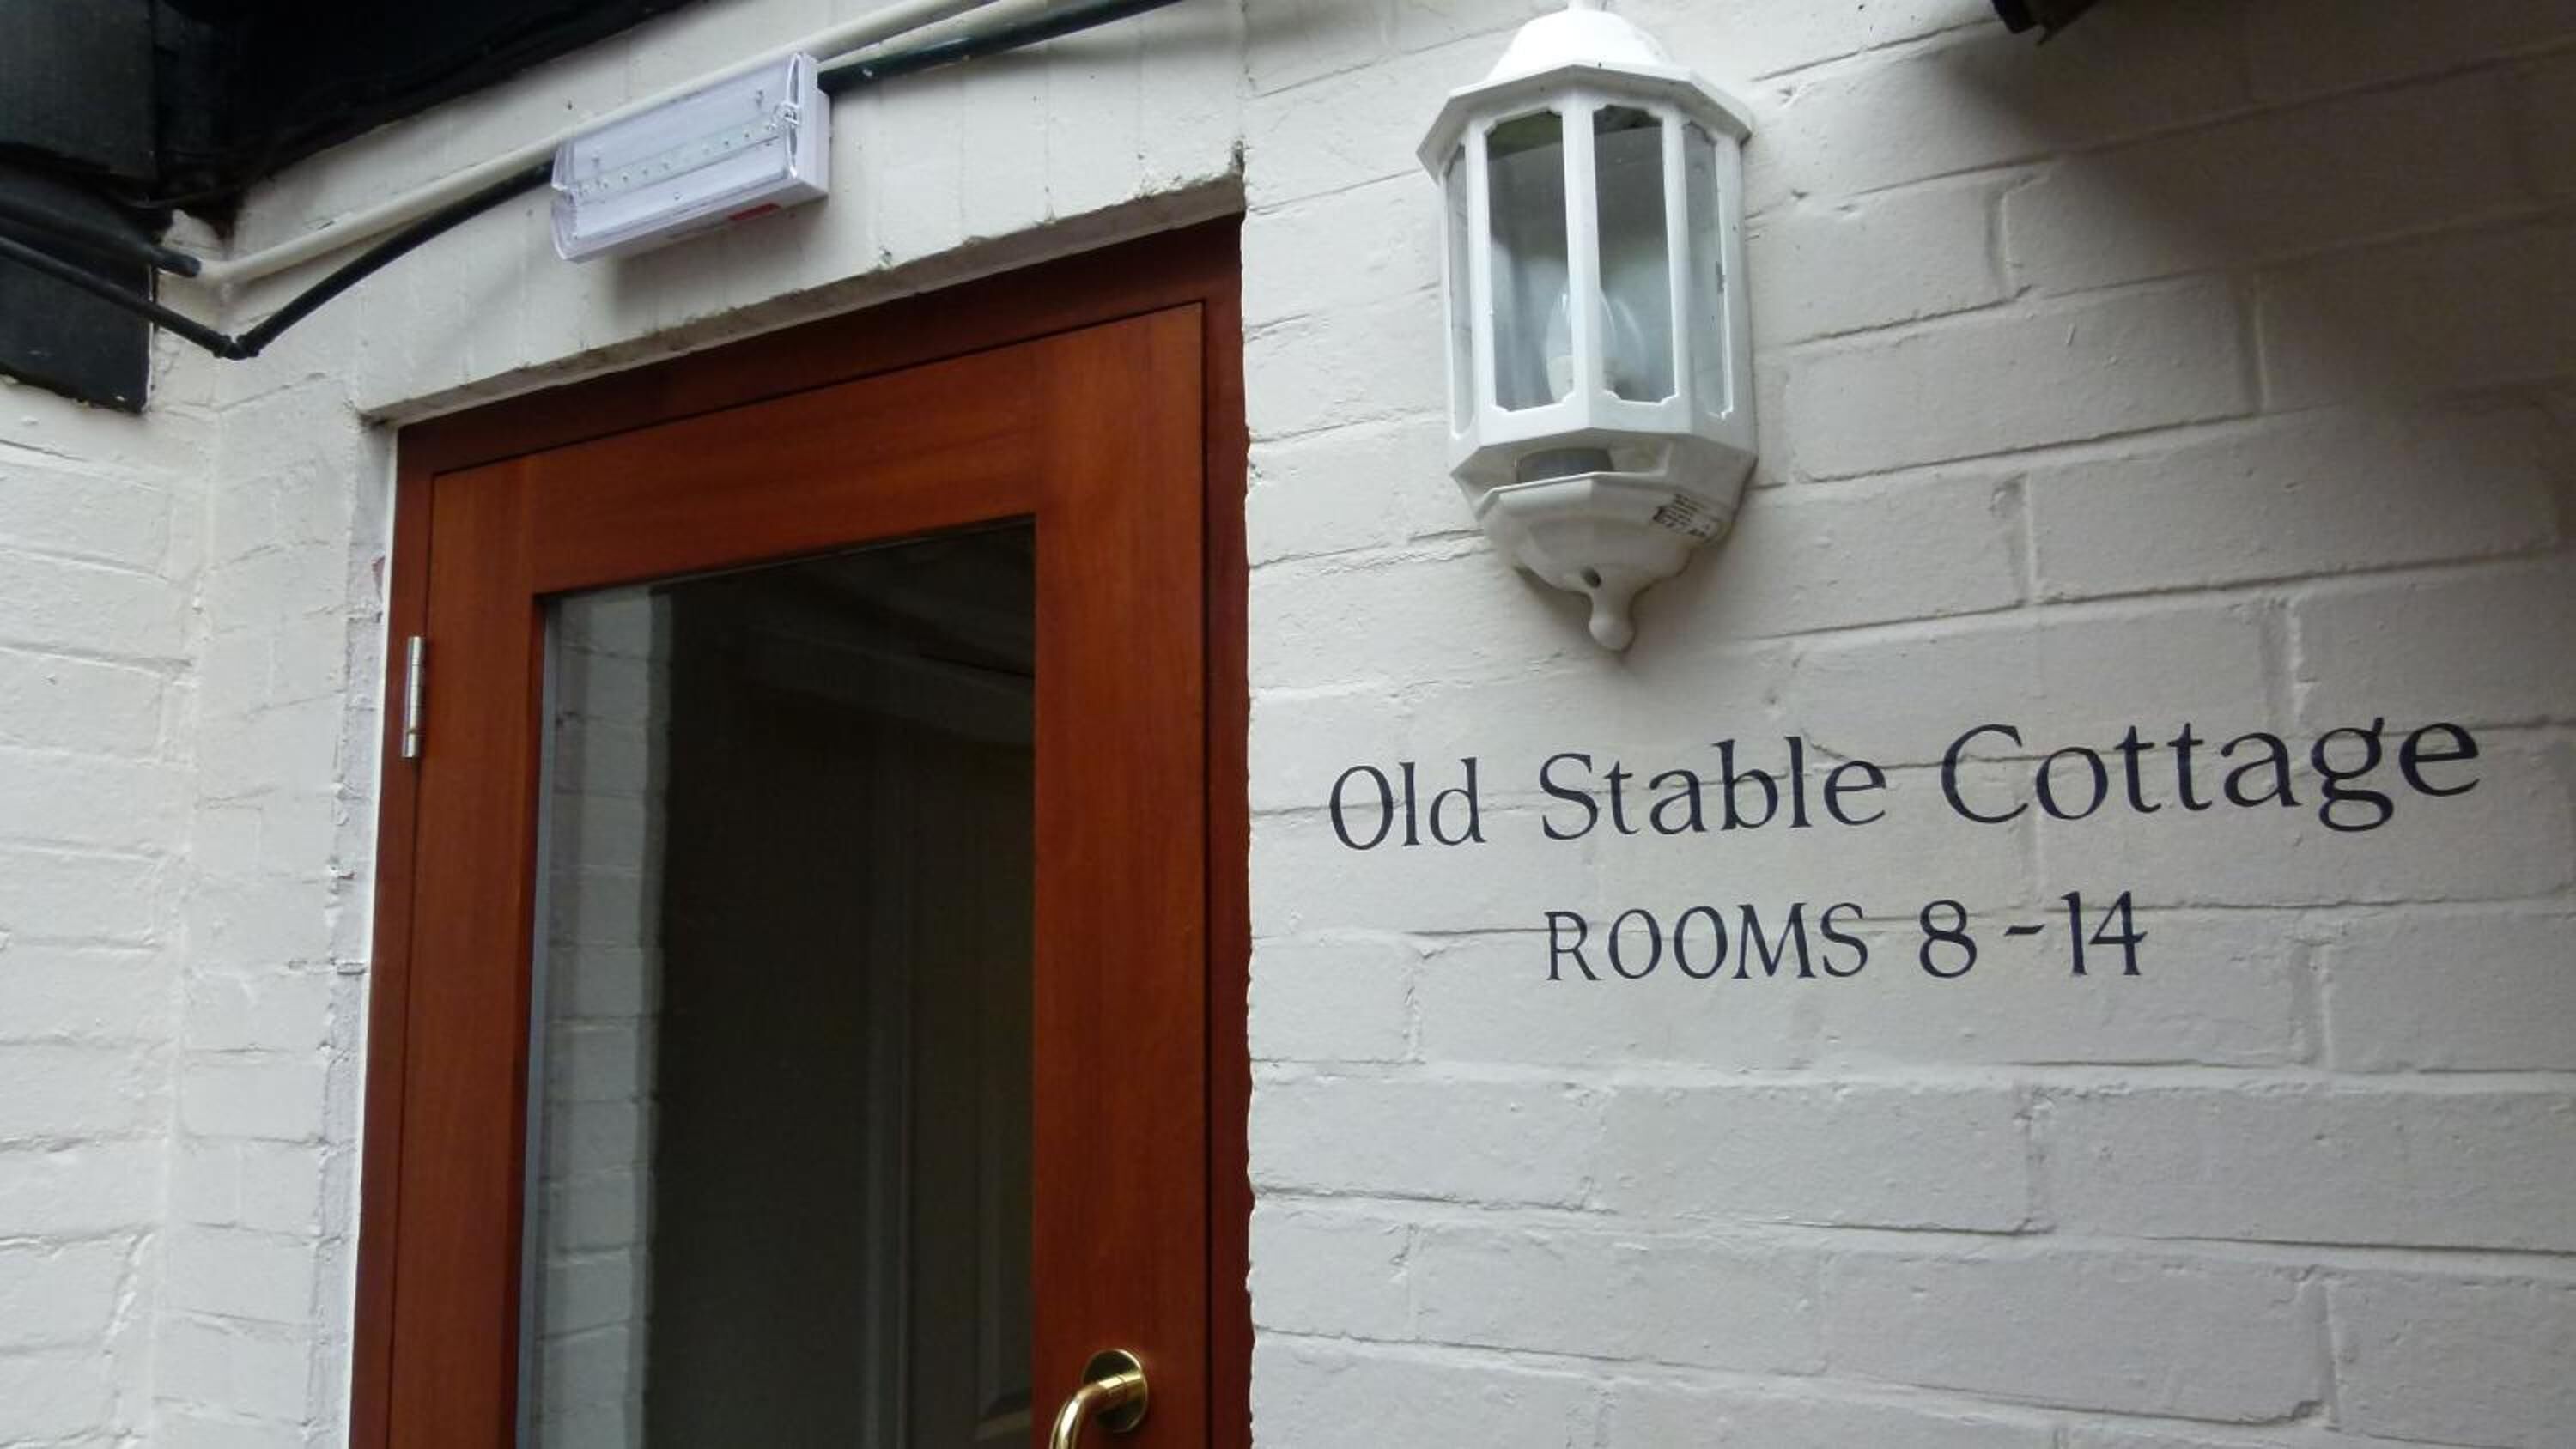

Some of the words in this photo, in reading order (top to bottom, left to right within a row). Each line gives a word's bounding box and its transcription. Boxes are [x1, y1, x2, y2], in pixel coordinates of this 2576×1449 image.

[1329, 757, 1486, 850] Old
[1540, 736, 1889, 840] Stable
[1941, 716, 2479, 833] Cottage
[1544, 902, 1868, 980] ROOMS
